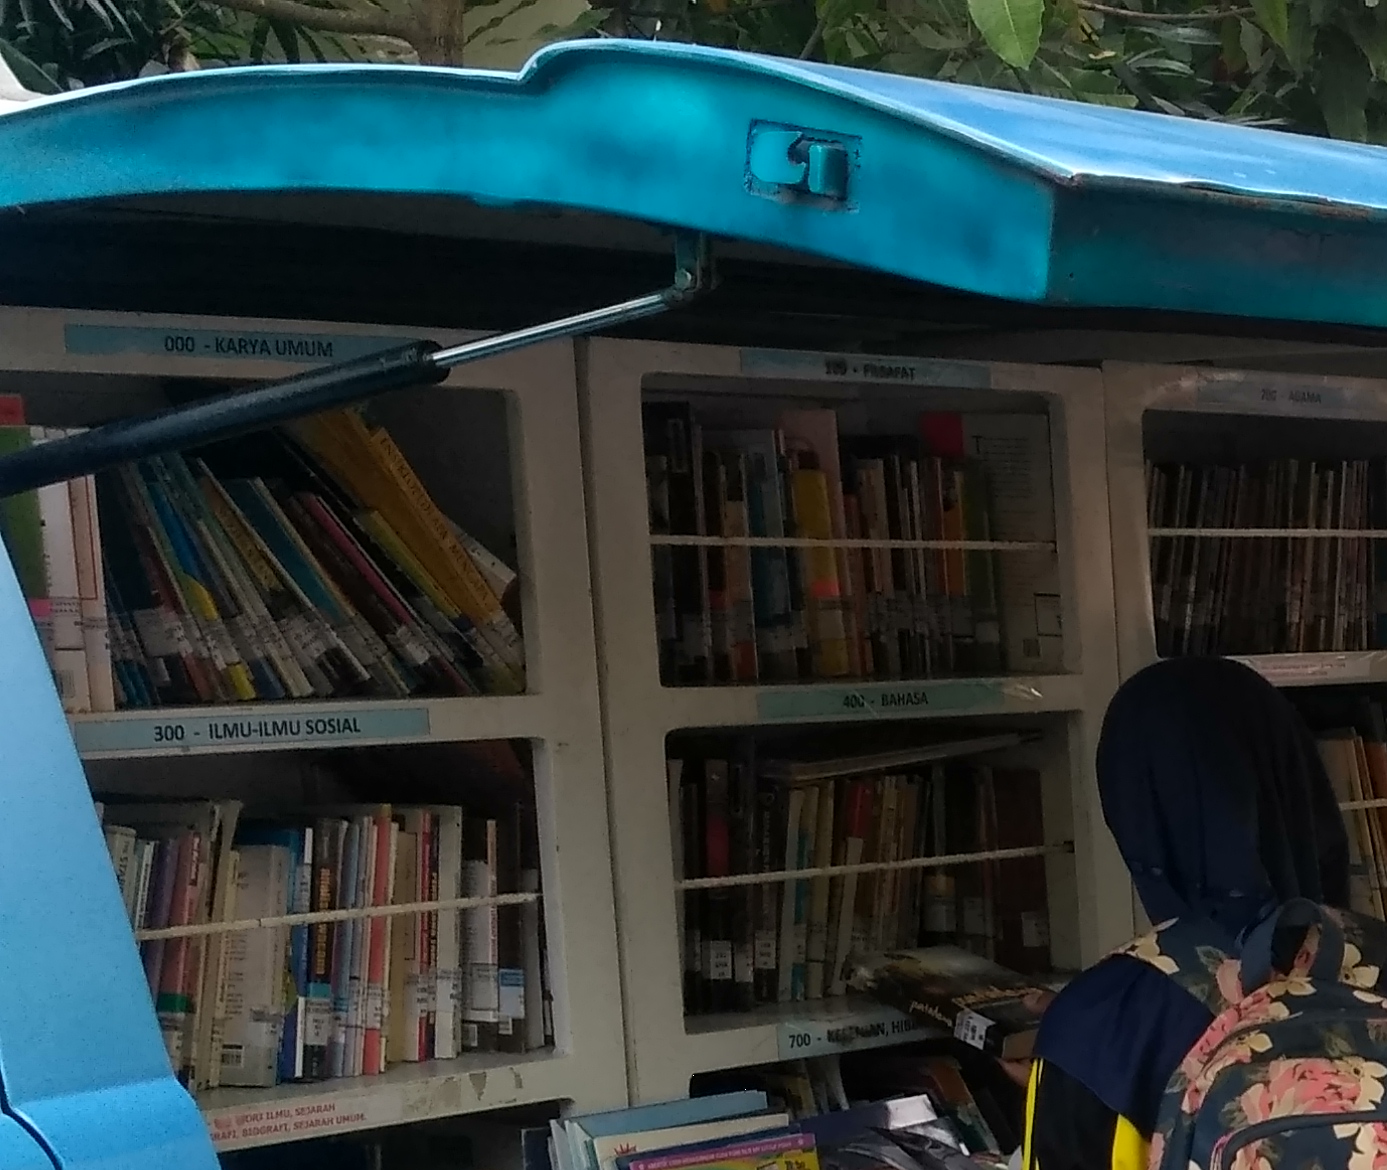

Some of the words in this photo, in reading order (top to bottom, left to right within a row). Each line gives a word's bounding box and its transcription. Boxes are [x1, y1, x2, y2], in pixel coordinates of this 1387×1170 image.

[164, 335, 195, 353] 000
[215, 336, 271, 356] KARYA
[275, 338, 334, 358] UMUM
[881, 692, 929, 706] BAHASA
[153, 724, 185, 742] 300
[208, 720, 302, 741] ILMU-ILMU
[305, 716, 361, 736] SOSIAL
[789, 1033, 811, 1048] 700
[295, 1103, 336, 1116] SEJARAH
[293, 1117, 334, 1131] SEJARAH
